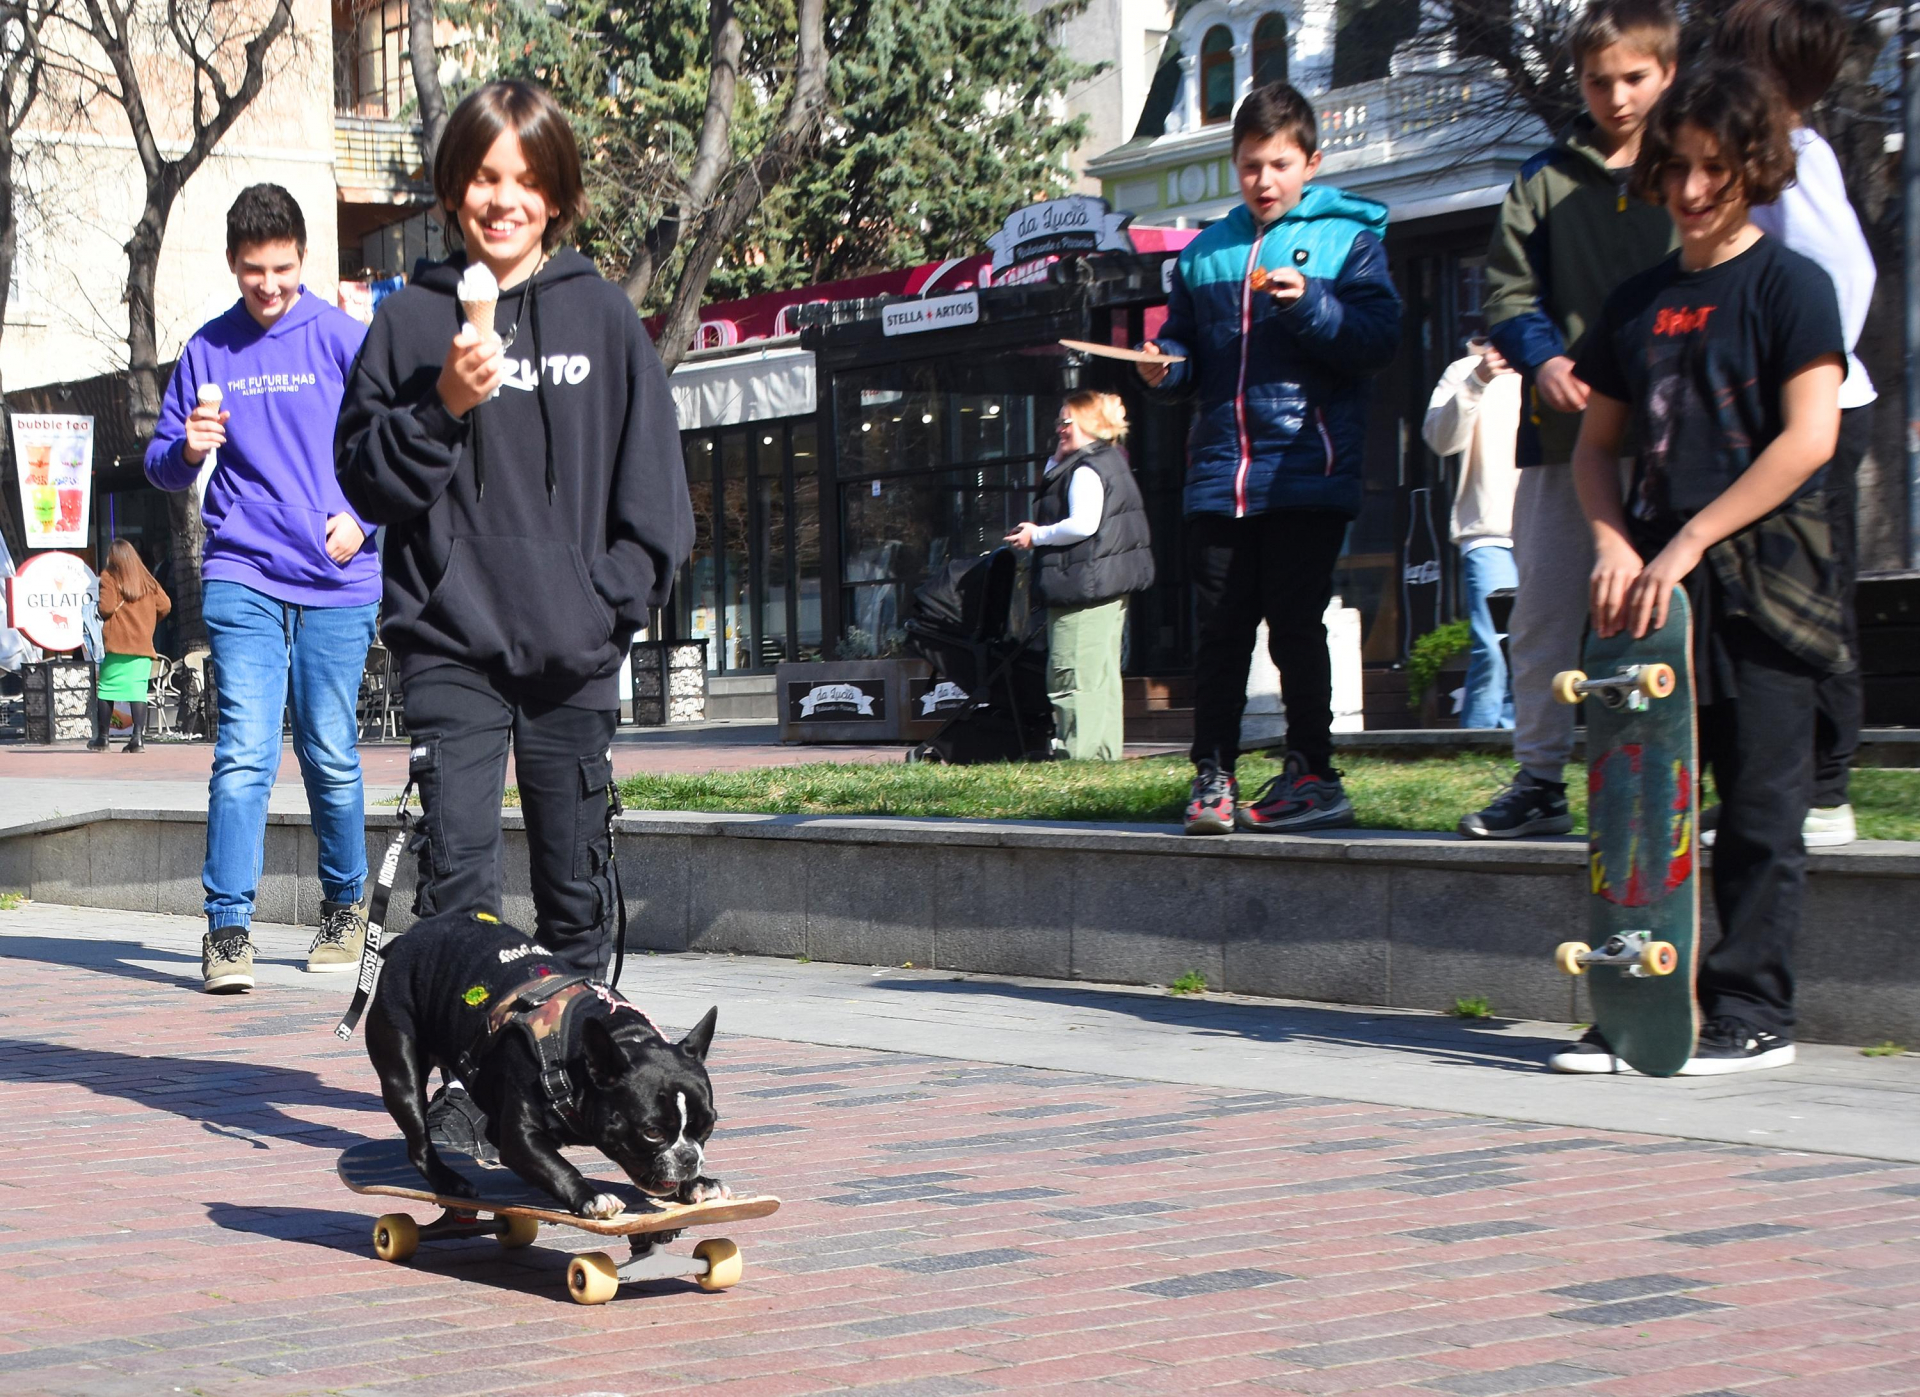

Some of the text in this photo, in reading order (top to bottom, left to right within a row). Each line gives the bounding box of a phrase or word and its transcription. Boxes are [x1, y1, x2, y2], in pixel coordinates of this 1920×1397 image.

[1017, 211, 1039, 238] da
[887, 302, 974, 327] STELLA ARTOIS
[227, 373, 316, 392] THE FUTURE HAS
[500, 355, 591, 391] RUTO
[17, 420, 89, 430] bubble tea
[27, 592, 93, 608] GELATO
[377, 843, 402, 888] FASHION
[358, 921, 382, 995] BEST FASHION
